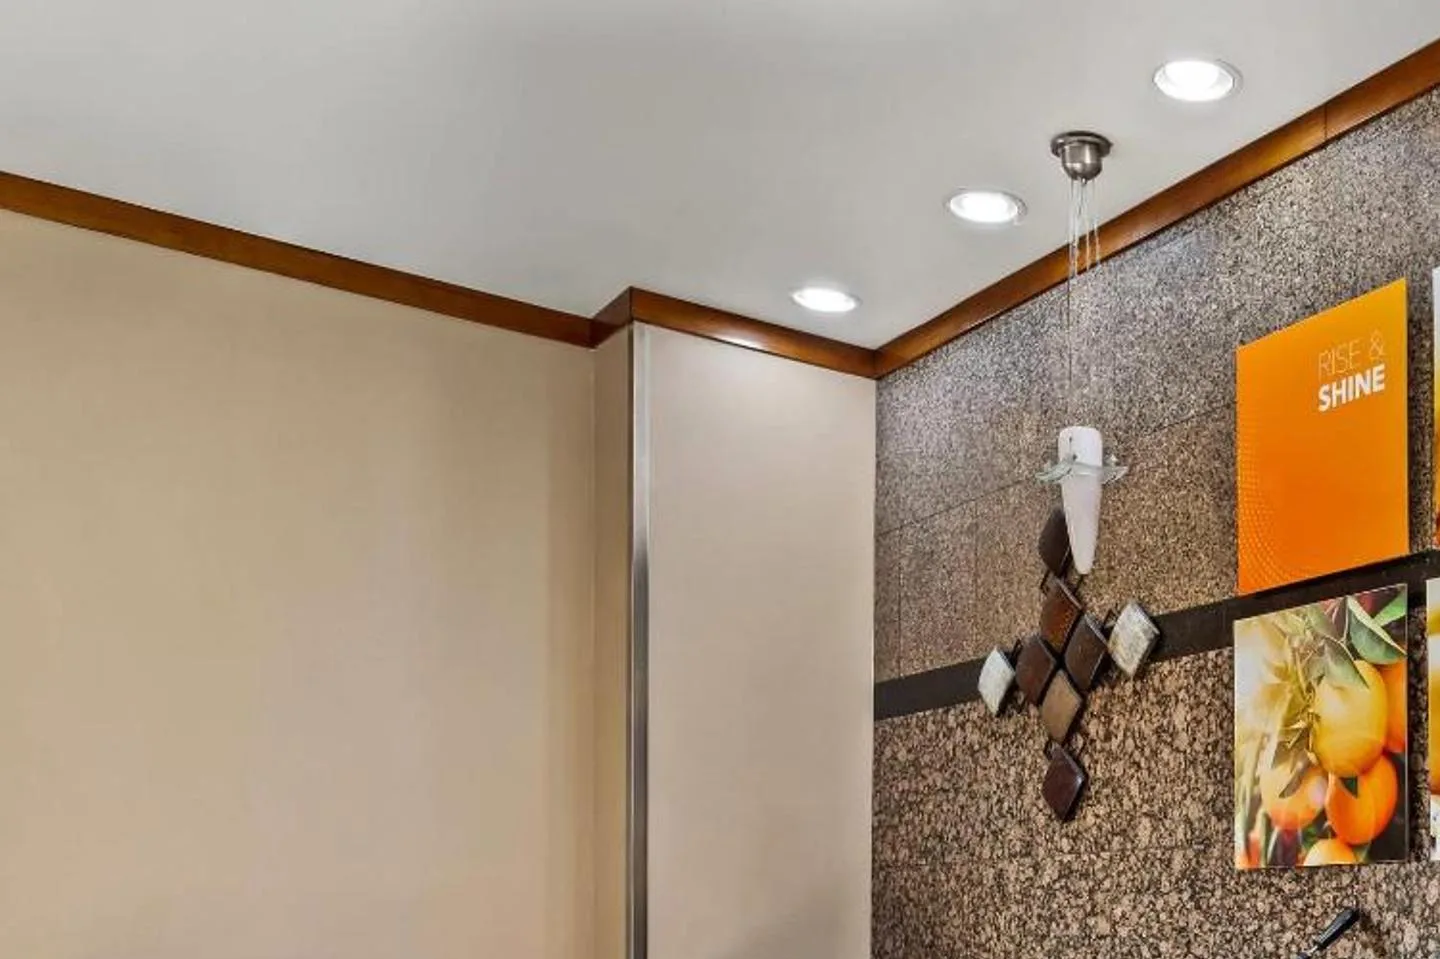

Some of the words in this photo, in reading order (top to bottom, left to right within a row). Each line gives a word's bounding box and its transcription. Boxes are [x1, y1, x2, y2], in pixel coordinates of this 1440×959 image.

[1318, 338, 1361, 381] RISE
[1369, 328, 1386, 362] &
[1318, 363, 1385, 412] SHINE
